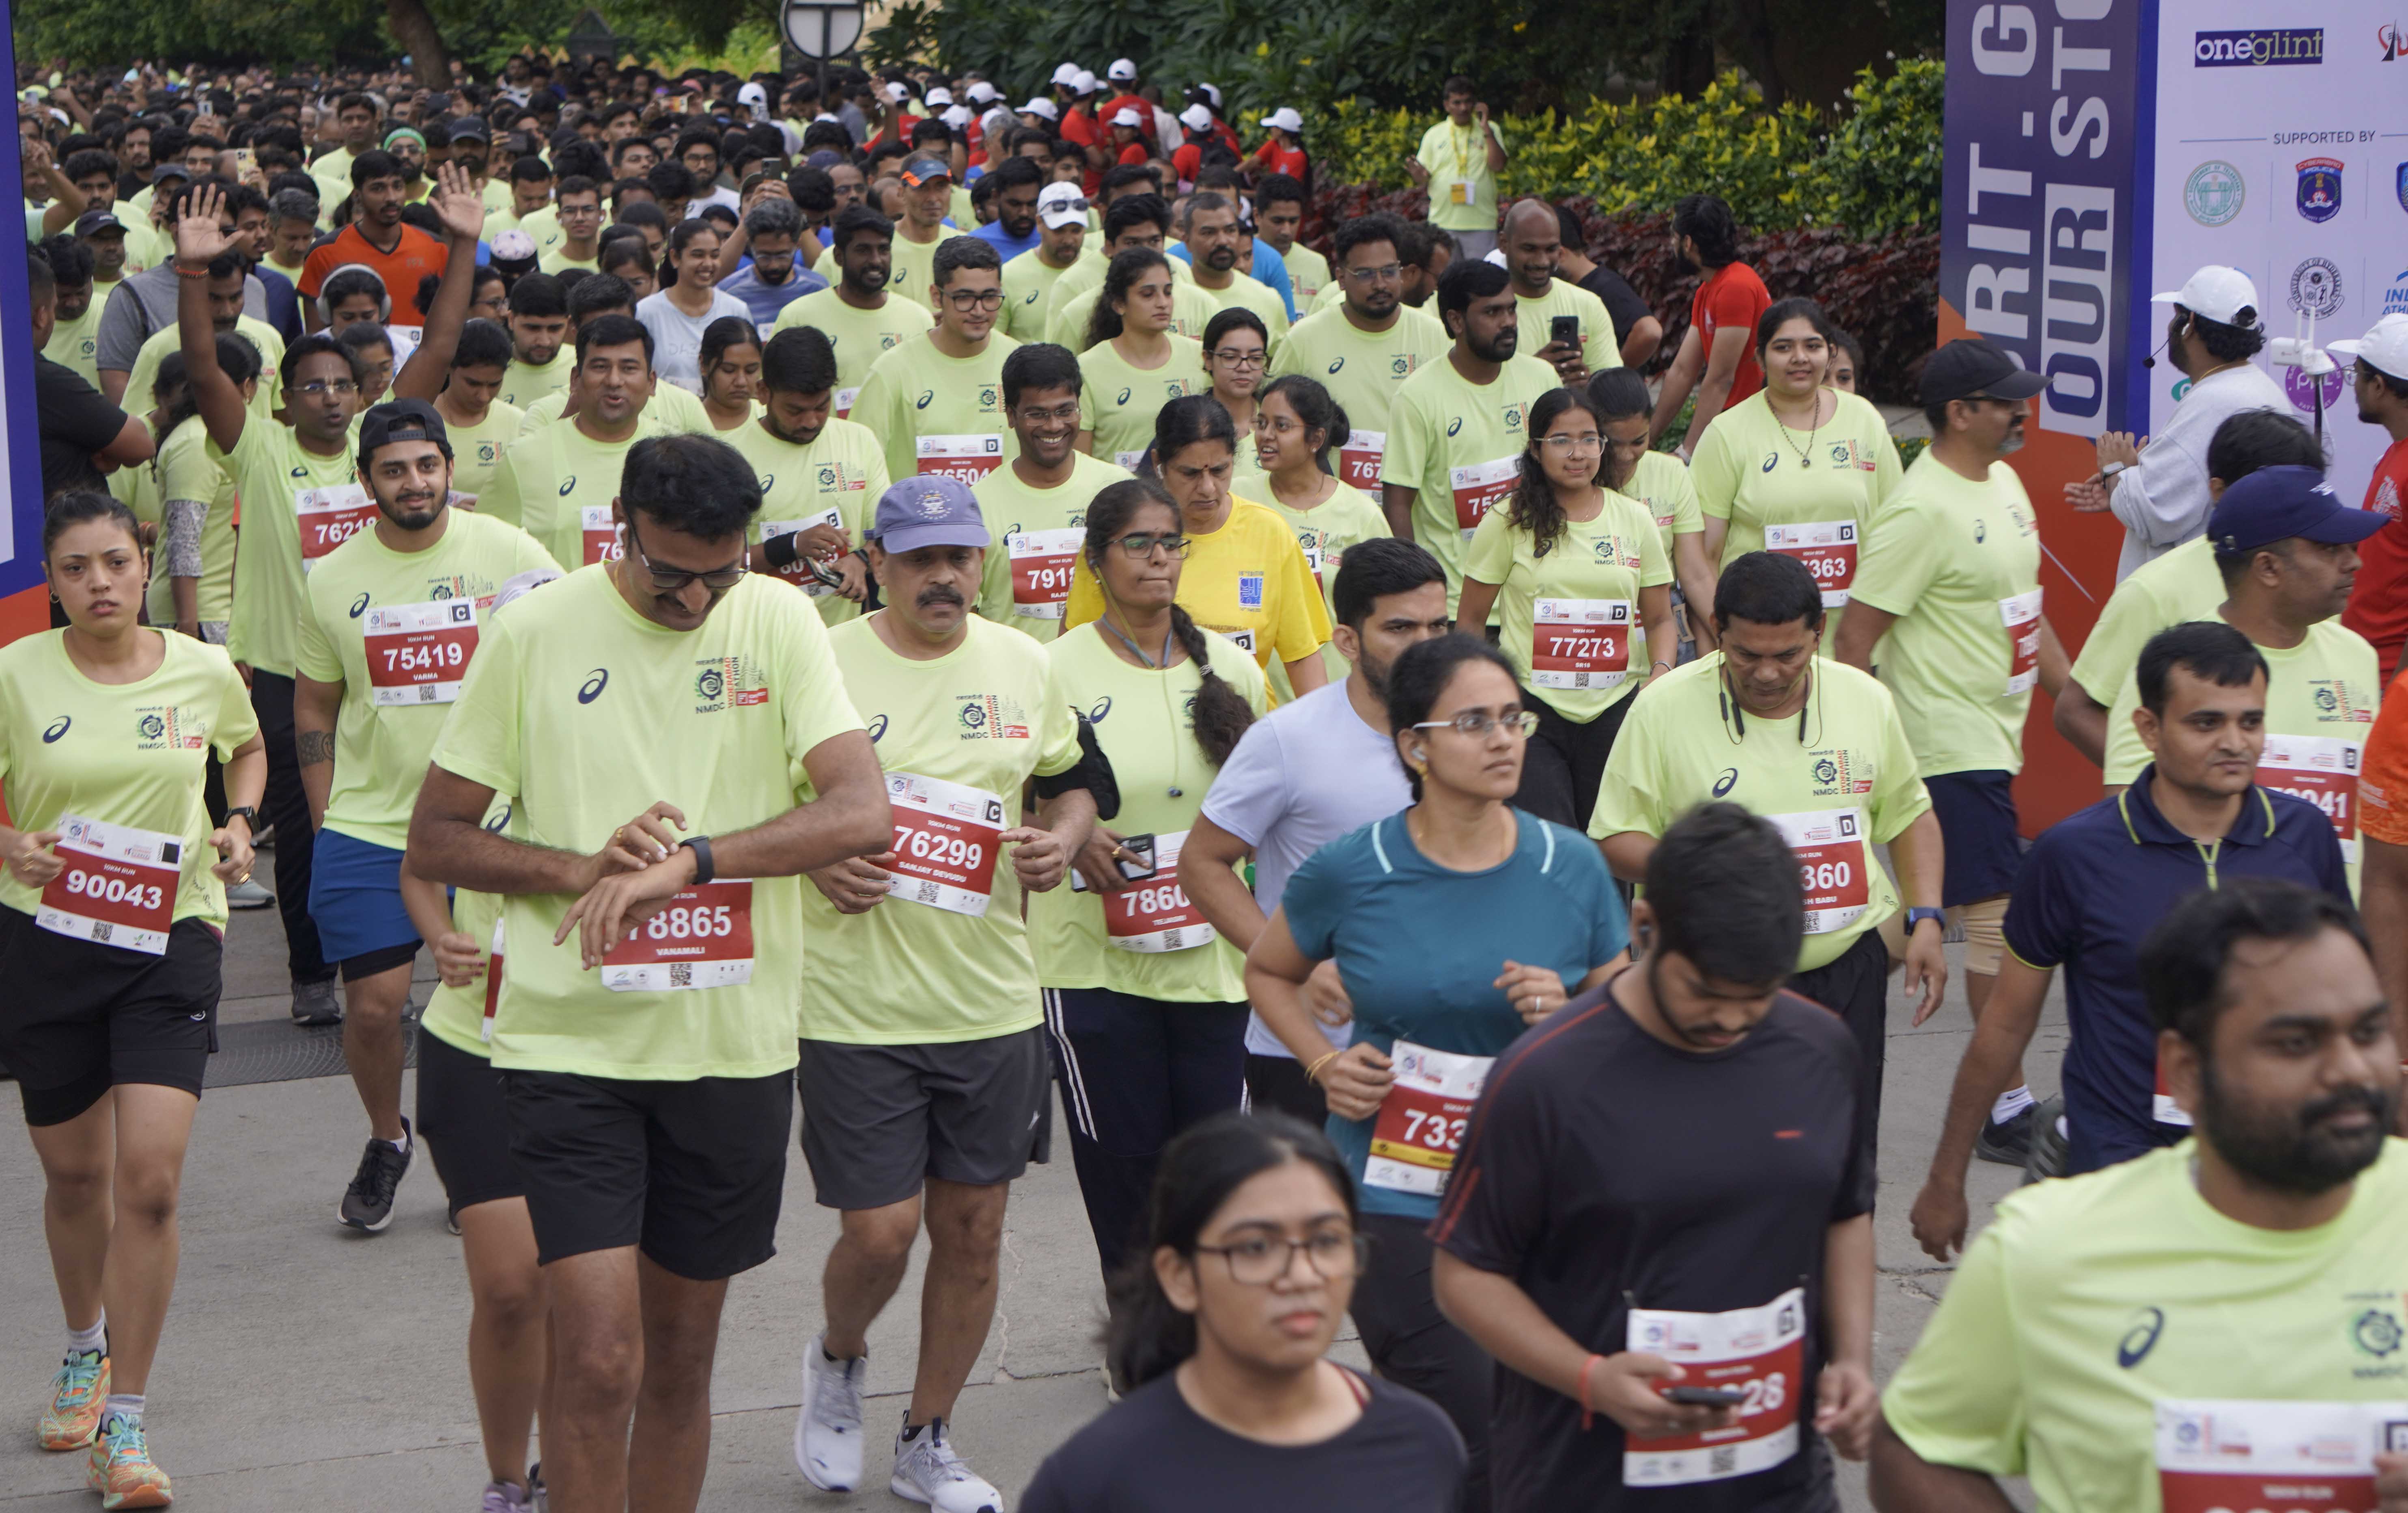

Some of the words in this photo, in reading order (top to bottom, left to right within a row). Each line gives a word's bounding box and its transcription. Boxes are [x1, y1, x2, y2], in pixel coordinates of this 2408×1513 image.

[2195, 31, 2323, 65] oneglint
[2049, 0, 2111, 159] ST
[2274, 131, 2354, 146] SUPPORTED
[2359, 130, 2376, 142] BY
[1965, 143, 2032, 371] RIT
[2045, 207, 2109, 418] OUR
[988, 441, 996, 451] D
[829, 516, 836, 526] C
[1843, 528, 1851, 539] D
[456, 607, 466, 620] C
[1615, 608, 1624, 619] D
[1550, 637, 1615, 657] 77273
[383, 642, 463, 672] 75419
[413, 672, 438, 681] VARMA
[732, 657, 741, 687] ATHON
[696, 702, 726, 714] NMDC
[986, 695, 997, 738] HYDERABAD
[992, 695, 1004, 738] MARATHON
[961, 732, 989, 740] NMDC
[1837, 750, 1846, 794] HYDERABAD
[1842, 750, 1852, 794] MARATHON
[1813, 788, 1839, 796] NMDC
[989, 805, 1000, 819] C
[945, 824, 961, 832] RUN
[1842, 819, 1854, 834] D
[893, 825, 982, 870] 76299
[103, 863, 121, 873] 10KM
[121, 867, 136, 876] RUN
[898, 861, 933, 874] SANJAY
[66, 869, 162, 910] 90043
[1815, 895, 1838, 904] BABU
[656, 947, 705, 956] VANAMALI
